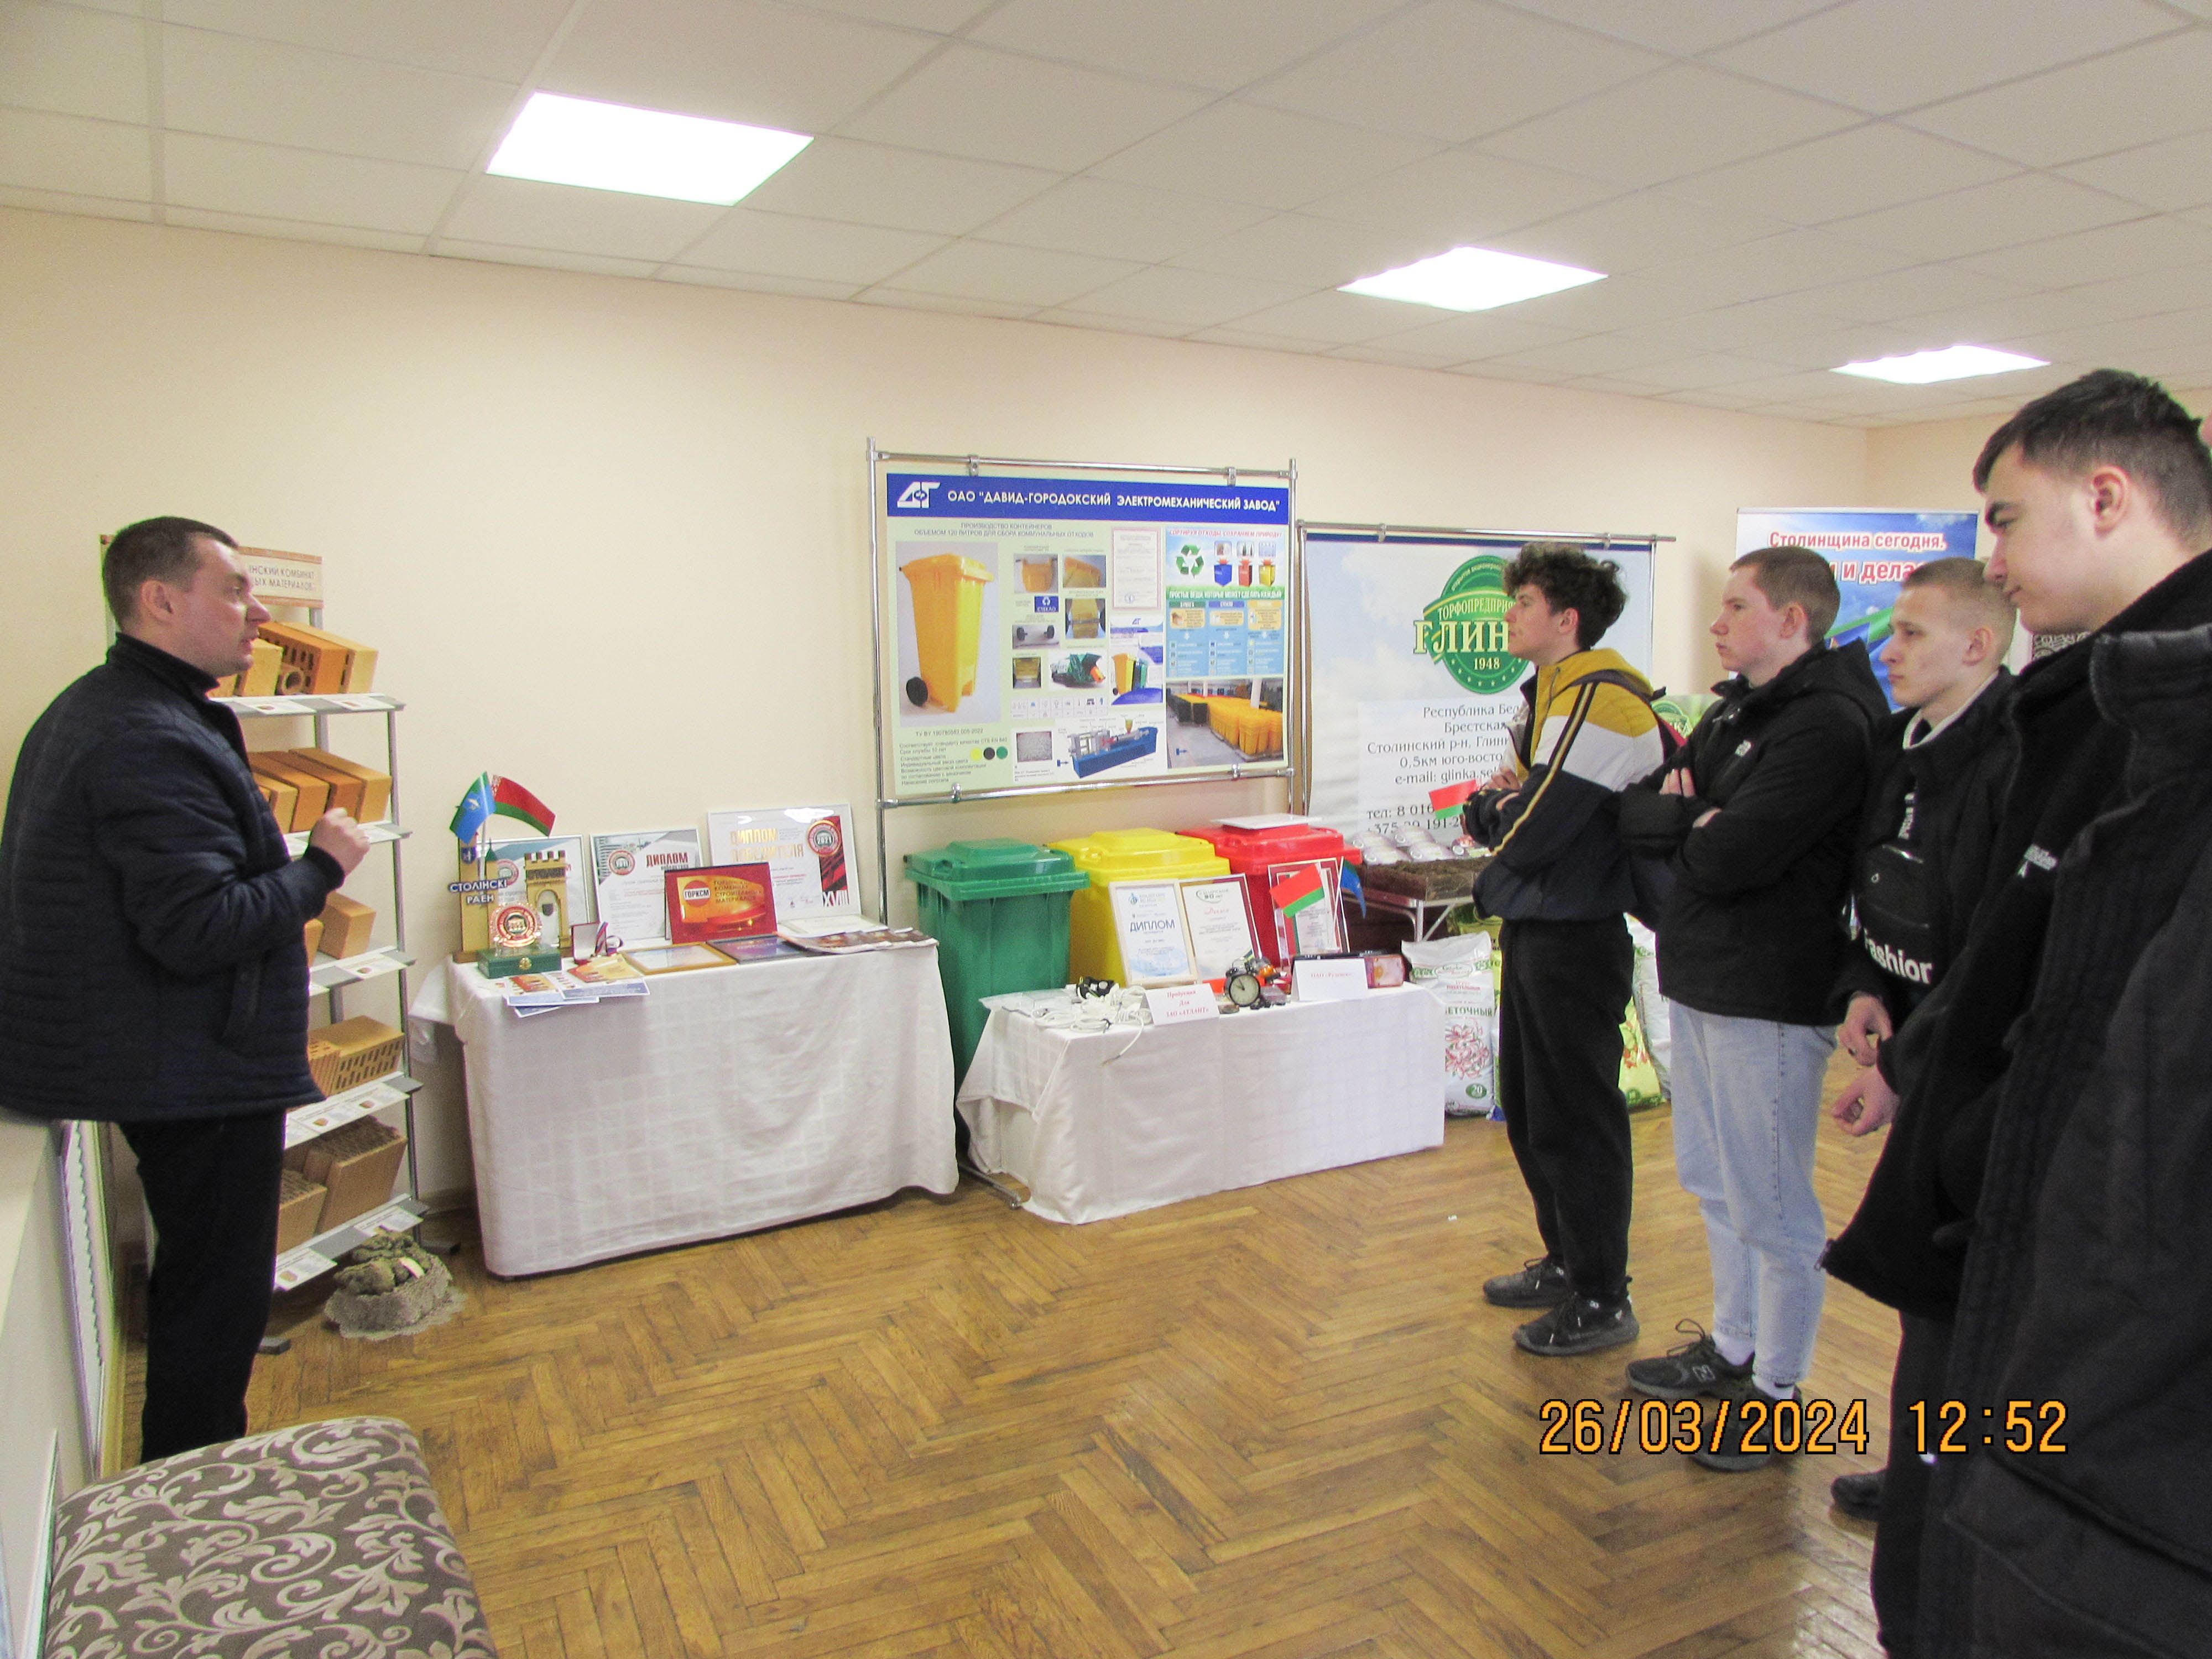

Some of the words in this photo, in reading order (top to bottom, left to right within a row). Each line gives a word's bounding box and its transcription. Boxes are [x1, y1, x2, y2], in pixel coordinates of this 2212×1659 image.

[947, 491, 975, 502] ОАО
[979, 492, 1110, 505] "ДАВИД-ГОРОДОКСКИЙ
[1117, 495, 1241, 510] ЭЛЕКТРОМЕХАНИЧЕСКИЙ
[1243, 499, 1280, 512] ЗАВОД"
[1770, 532, 1870, 551] Столинщина
[1861, 563, 1916, 584] дела
[1439, 597, 1517, 620] ТОРФОПРЕДПРИЯ
[1413, 620, 1509, 654] ГЛИН
[1474, 657, 1500, 670] 1948
[1423, 705, 1494, 719] Республика
[1499, 705, 1519, 715] Бел
[1368, 739, 1445, 754] Столинский
[1450, 739, 1470, 752] р-н,
[1400, 756, 1437, 769] 0,5км
[1442, 753, 1503, 765] юго-восто
[1395, 772, 1437, 785] e-mail:
[1366, 807, 1392, 819] тел:
[1397, 805, 1405, 816] 8
[1410, 805, 1435, 815] 016
[1427, 818, 1460, 830] 191-2
[646, 852, 688, 868] ДИПЛОМ
[449, 879, 507, 893] СТОЛІНСКІ
[684, 889, 709, 899] ГОРКСМ
[822, 890, 850, 907] XVIII
[1130, 920, 1175, 932] ДИПЛОМ
[1445, 1005, 1493, 1016] ЕТОЧНЫЙ
[1471, 1084, 1483, 1095] 20
